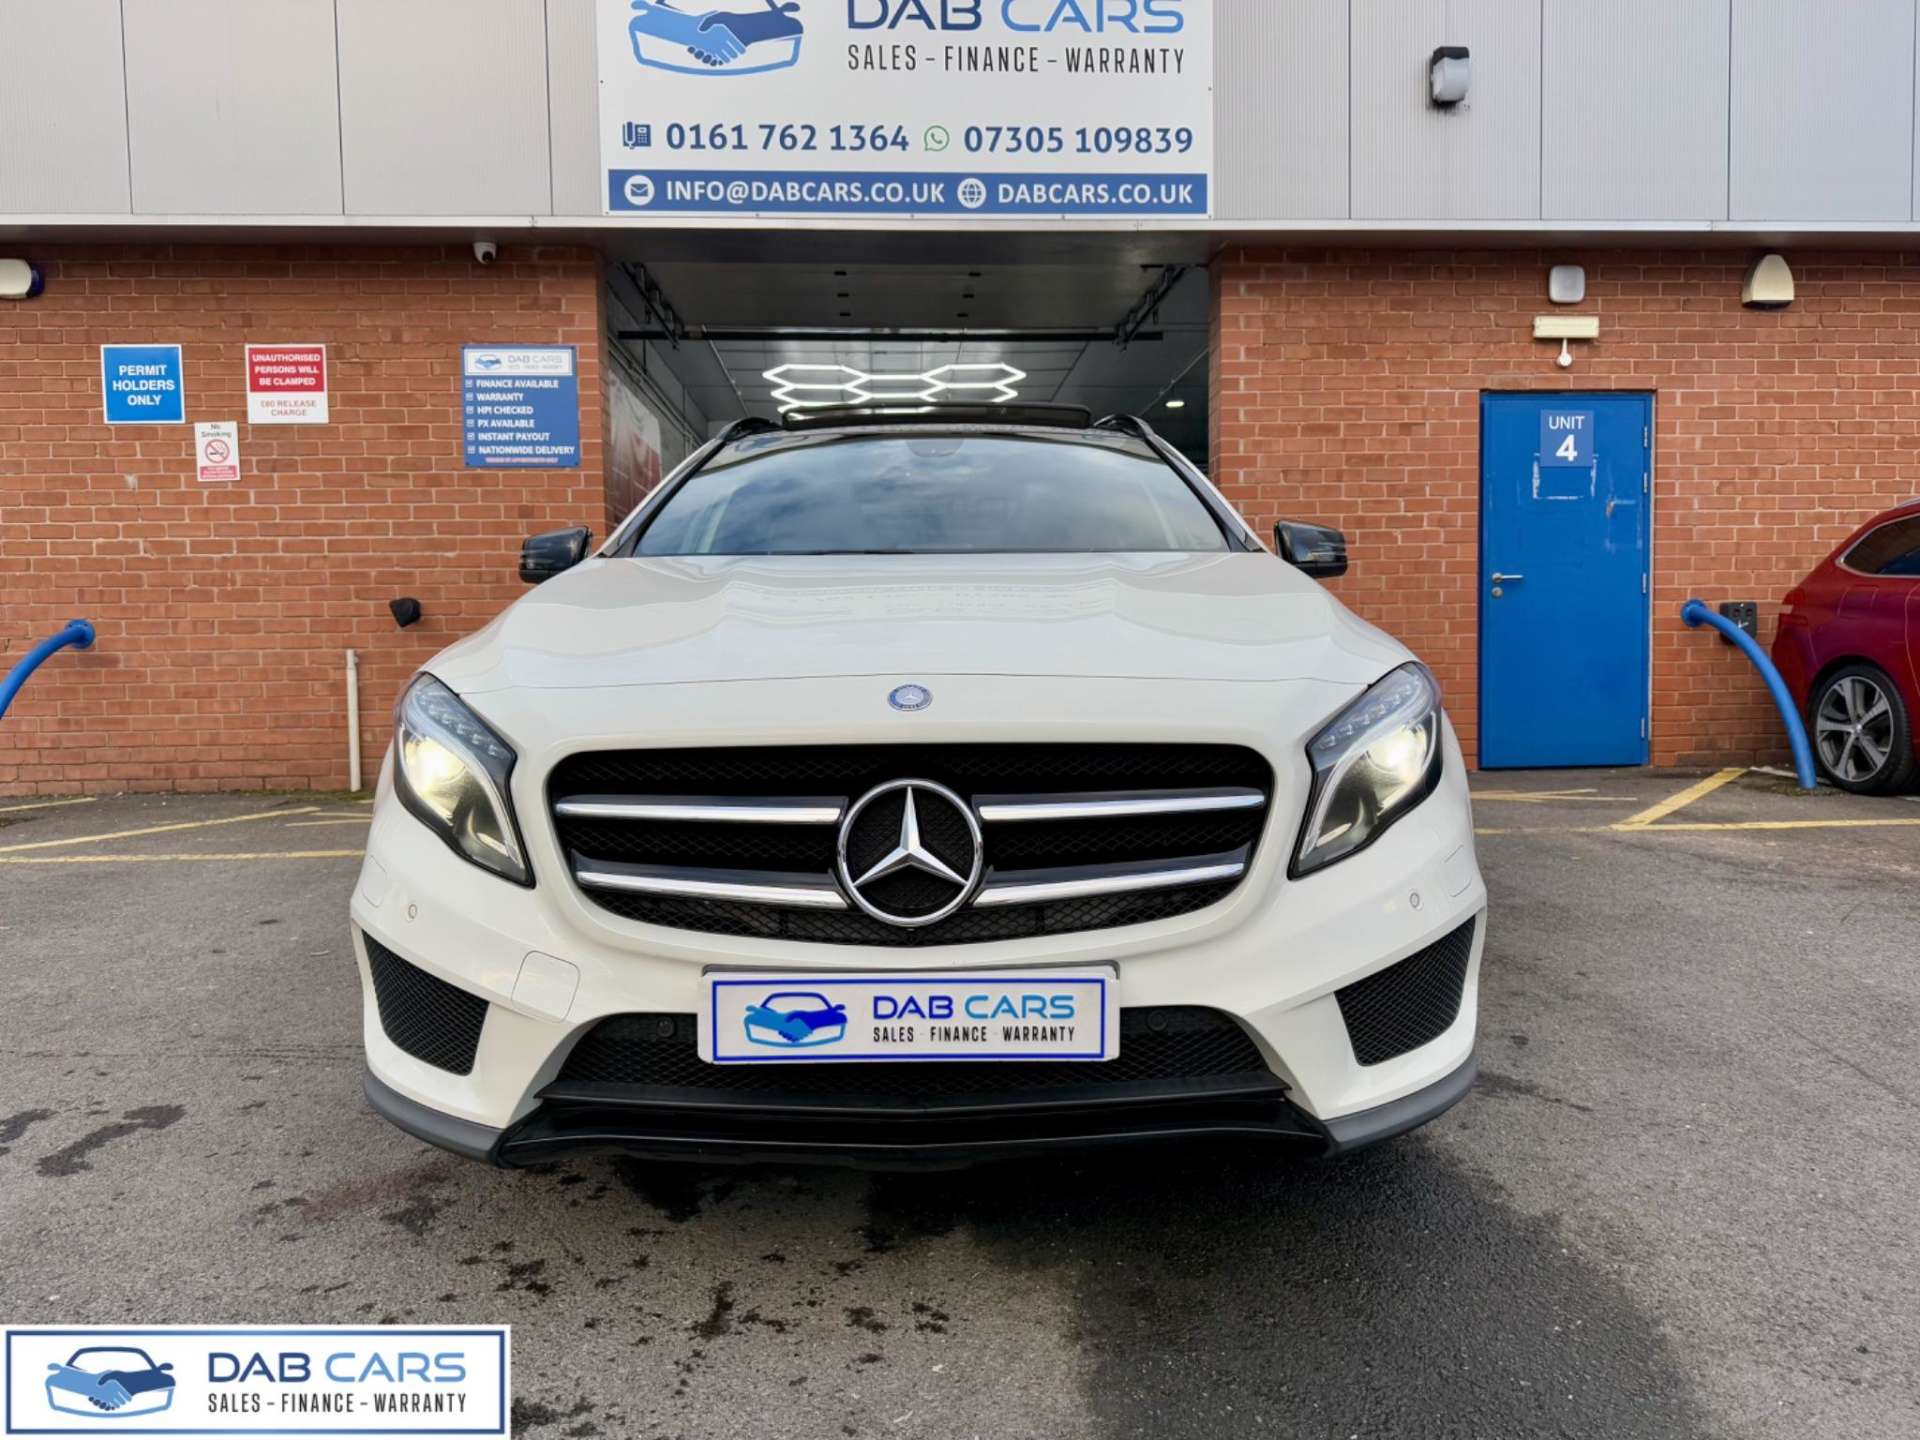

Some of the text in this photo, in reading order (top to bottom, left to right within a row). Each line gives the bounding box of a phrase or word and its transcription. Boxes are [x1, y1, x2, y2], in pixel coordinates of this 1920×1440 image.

[848, 0, 1184, 33] DAB CARS
[848, 44, 917, 70] SALES
[945, 46, 1038, 72] FINANCE
[1065, 48, 1184, 73] WARRANTY
[666, 123, 909, 151] 0161 762 1364
[963, 126, 1193, 154] 07305 109839
[666, 181, 945, 204] INFO@DABCARS.CO.UK
[998, 183, 1193, 204] DABCARS.CO.UK
[252, 354, 320, 362] UNAUTHORISED
[119, 364, 168, 376] PERMIT
[254, 366, 320, 374] PERSONS WILL
[112, 380, 175, 391] HOLDERS
[259, 377, 316, 386] BE CLAMPED
[476, 379, 559, 388] FINANCE AVAILABLE
[127, 395, 163, 406] ONLY
[476, 392, 524, 401] WARRANTY
[277, 399, 317, 408] RELEASE
[494, 405, 534, 414] CHECKED
[477, 419, 535, 428] PX AVAILABLE
[1548, 415, 1585, 429] UNIT
[478, 432, 551, 441] INSTANT PAYOUT
[478, 445, 575, 454] NATIONWIDE DELIVERY
[1555, 434, 1578, 462] 4
[873, 995, 1075, 1019] DAB CARS
[873, 1026, 1075, 1042] SALES FINANCE WARRANTY
